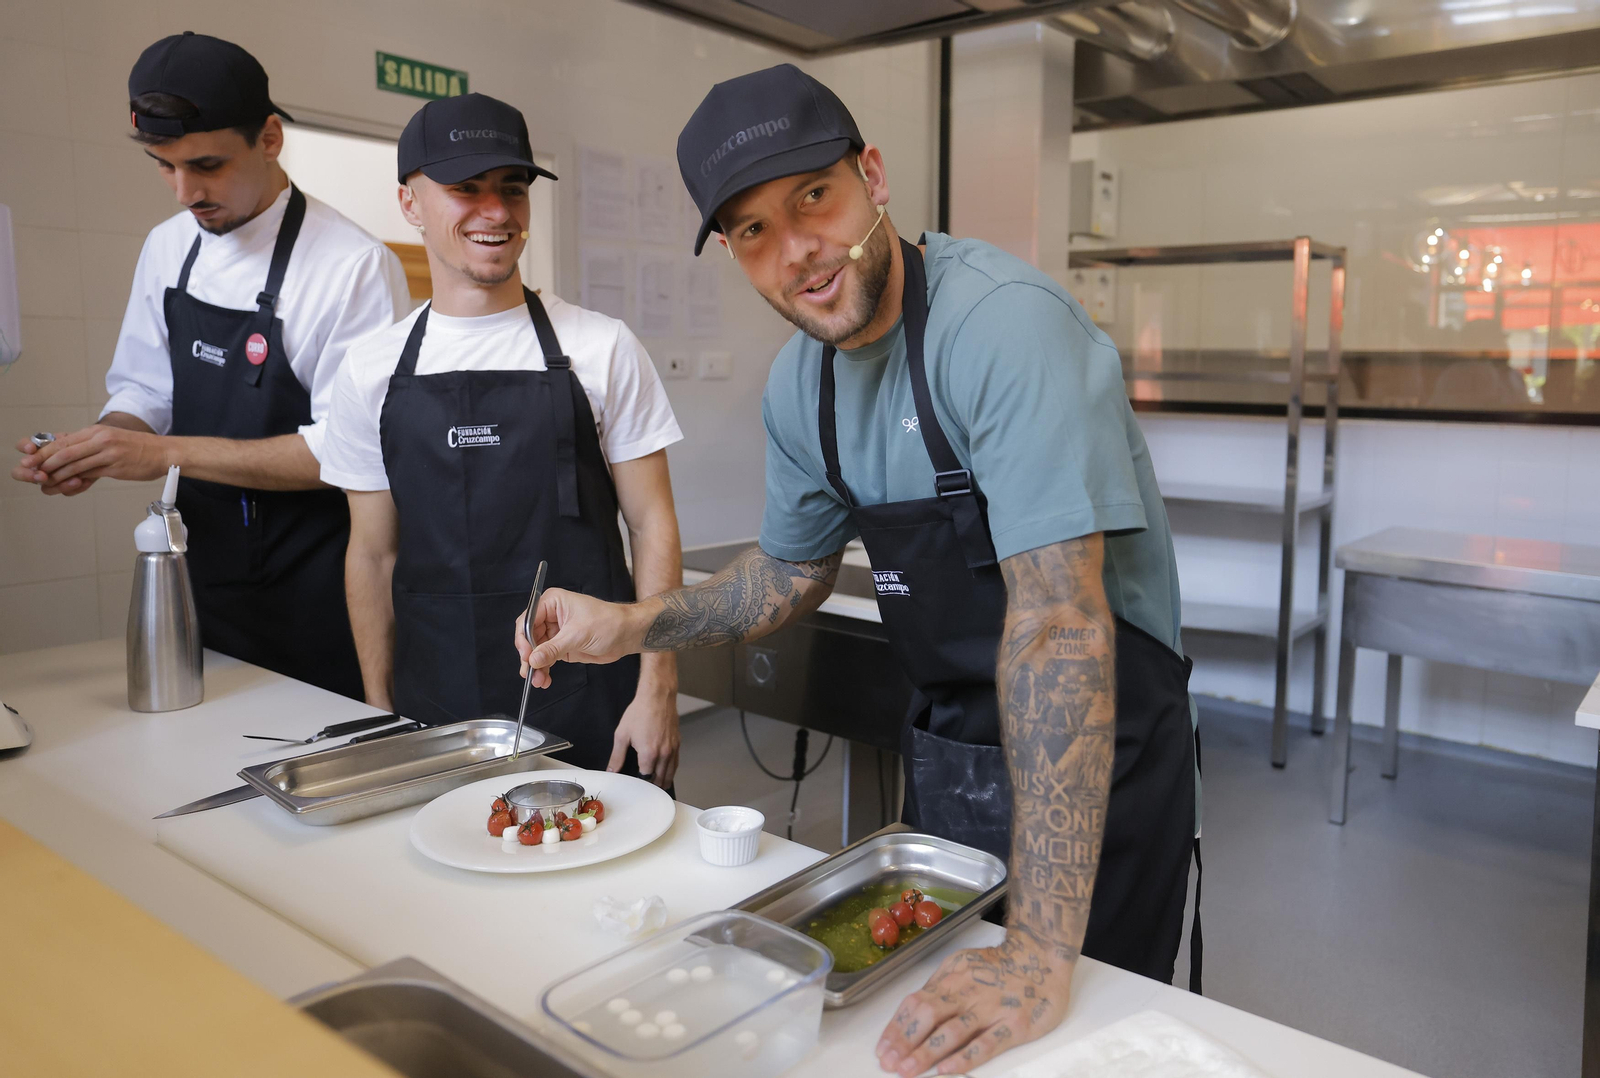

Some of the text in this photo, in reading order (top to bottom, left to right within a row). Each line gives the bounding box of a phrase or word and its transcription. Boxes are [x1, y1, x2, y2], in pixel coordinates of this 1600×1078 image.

[384, 59, 461, 98] SALIDA
[701, 114, 791, 178] Cruzcampo
[457, 426, 492, 437] FUNDACIÓN
[458, 435, 500, 446] Cruzcampo
[1048, 624, 1097, 641] GAMER
[1055, 642, 1091, 656] ZONE
